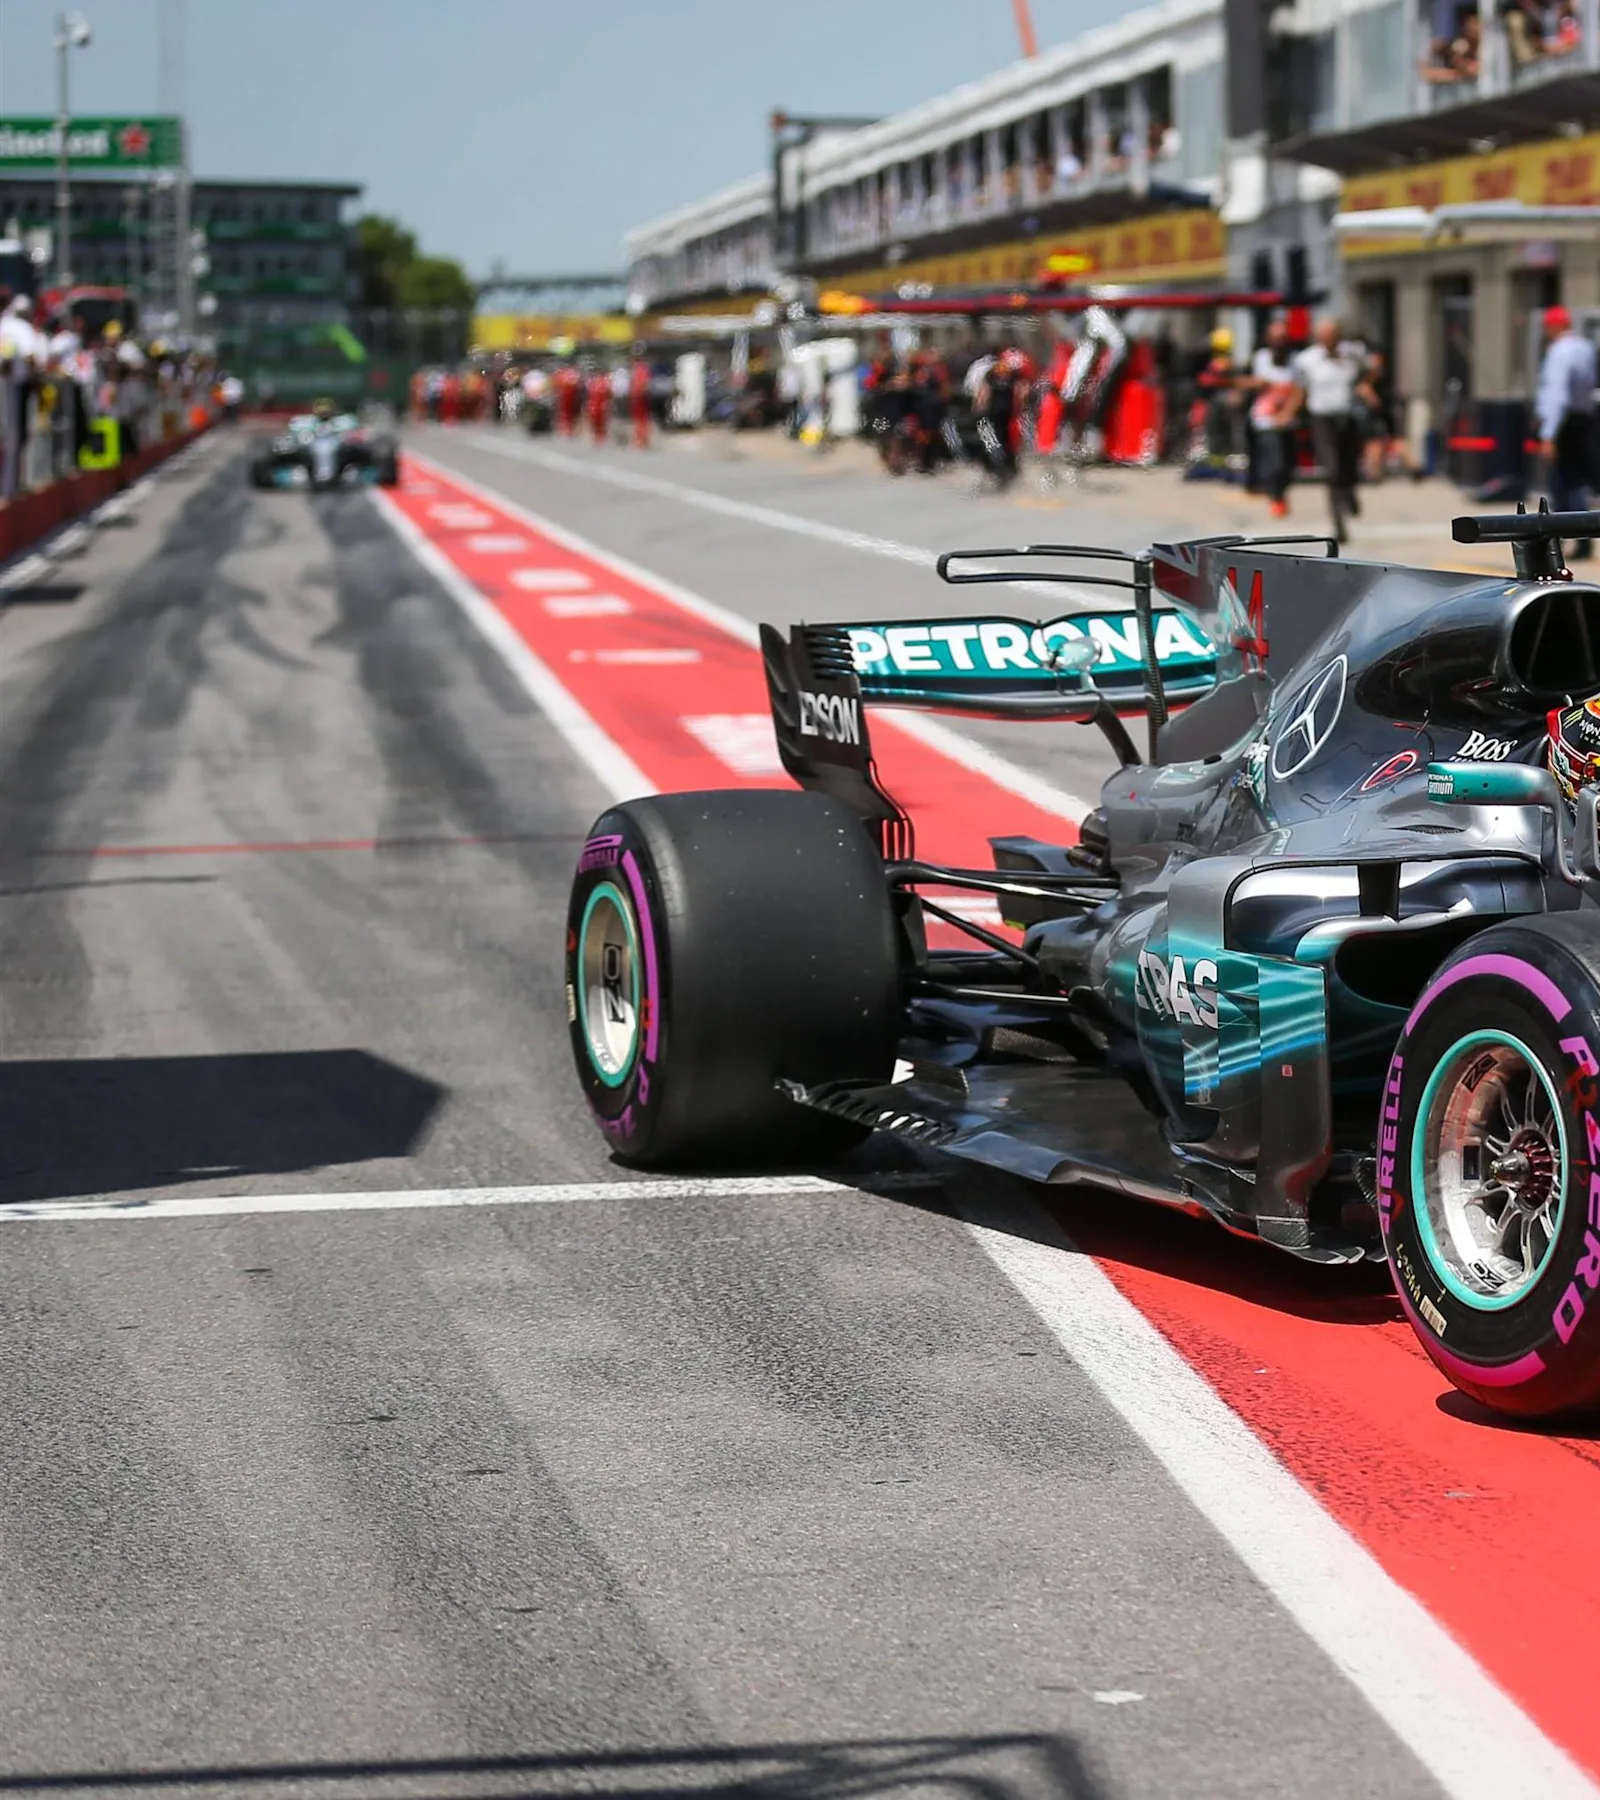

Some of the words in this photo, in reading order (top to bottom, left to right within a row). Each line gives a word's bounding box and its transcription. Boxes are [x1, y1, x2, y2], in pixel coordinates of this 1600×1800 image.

[846, 614, 1216, 671] PETRONA
[799, 690, 860, 746] EPSON
[1456, 729, 1519, 762] BOSS
